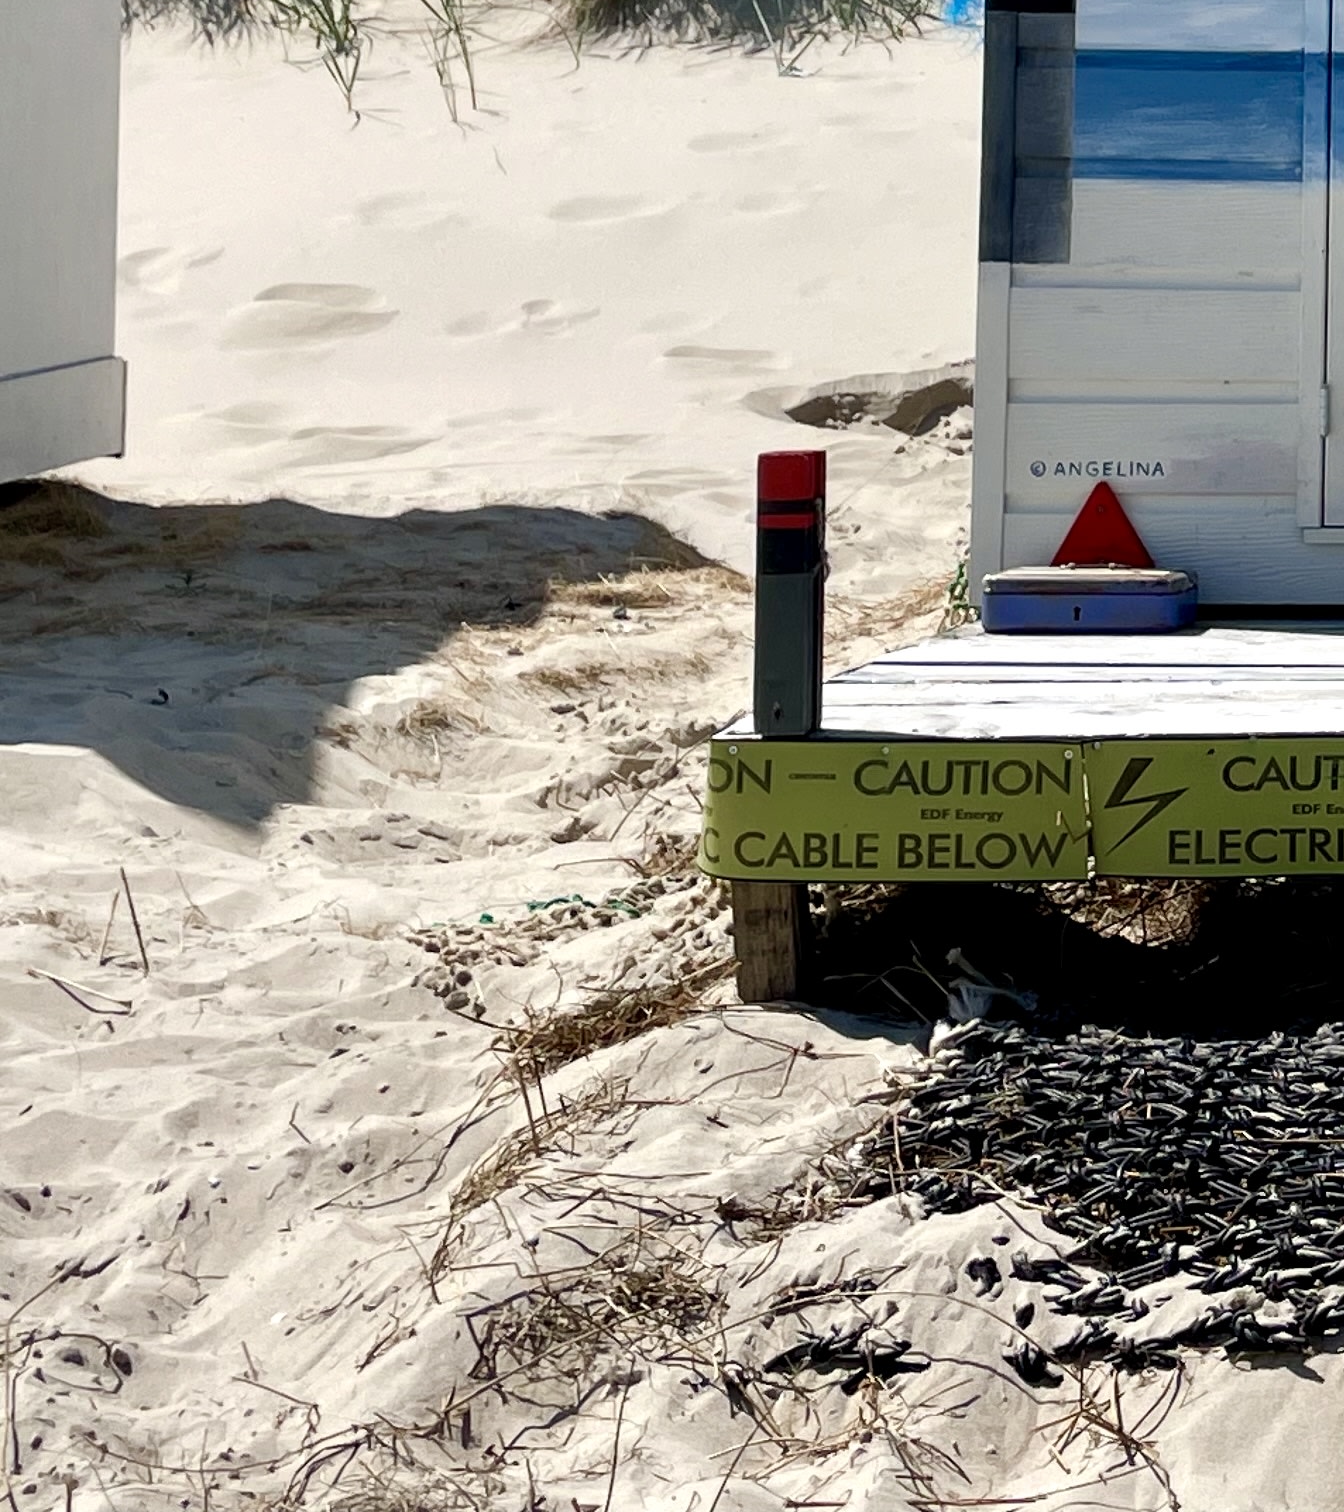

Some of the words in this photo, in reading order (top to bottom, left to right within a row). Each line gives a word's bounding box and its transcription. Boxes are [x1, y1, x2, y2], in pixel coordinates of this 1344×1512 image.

[1054, 460, 1165, 477] ANGELINA
[853, 758, 1072, 797] CAUTION
[919, 808, 951, 821] EDF
[954, 808, 1004, 823] Energy
[1291, 803, 1322, 816] EDF
[733, 830, 880, 869] CABLE
[897, 831, 1069, 869] BELOW
